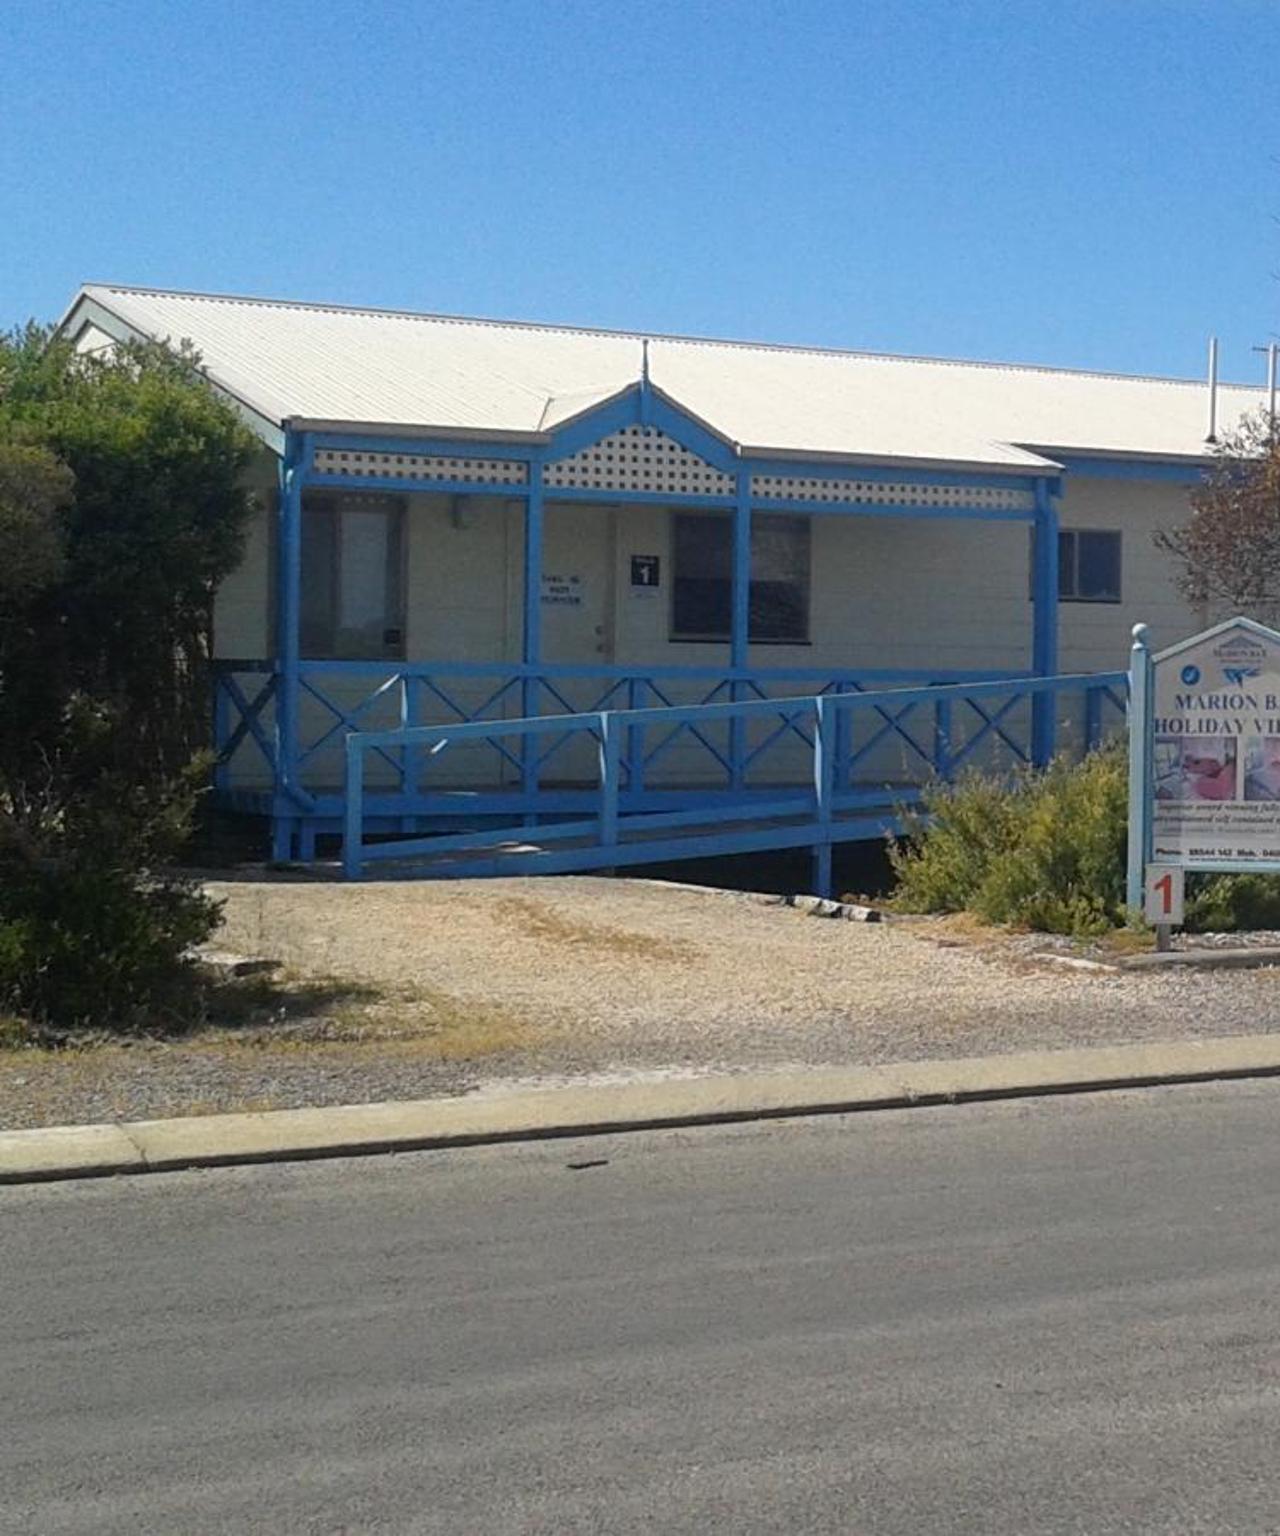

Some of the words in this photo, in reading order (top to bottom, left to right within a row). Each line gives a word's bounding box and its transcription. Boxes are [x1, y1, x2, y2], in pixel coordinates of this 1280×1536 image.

[1175, 693, 1257, 711] MARION
[1154, 717, 1244, 735] HOLIDAY
[1154, 873, 1172, 914] 1
